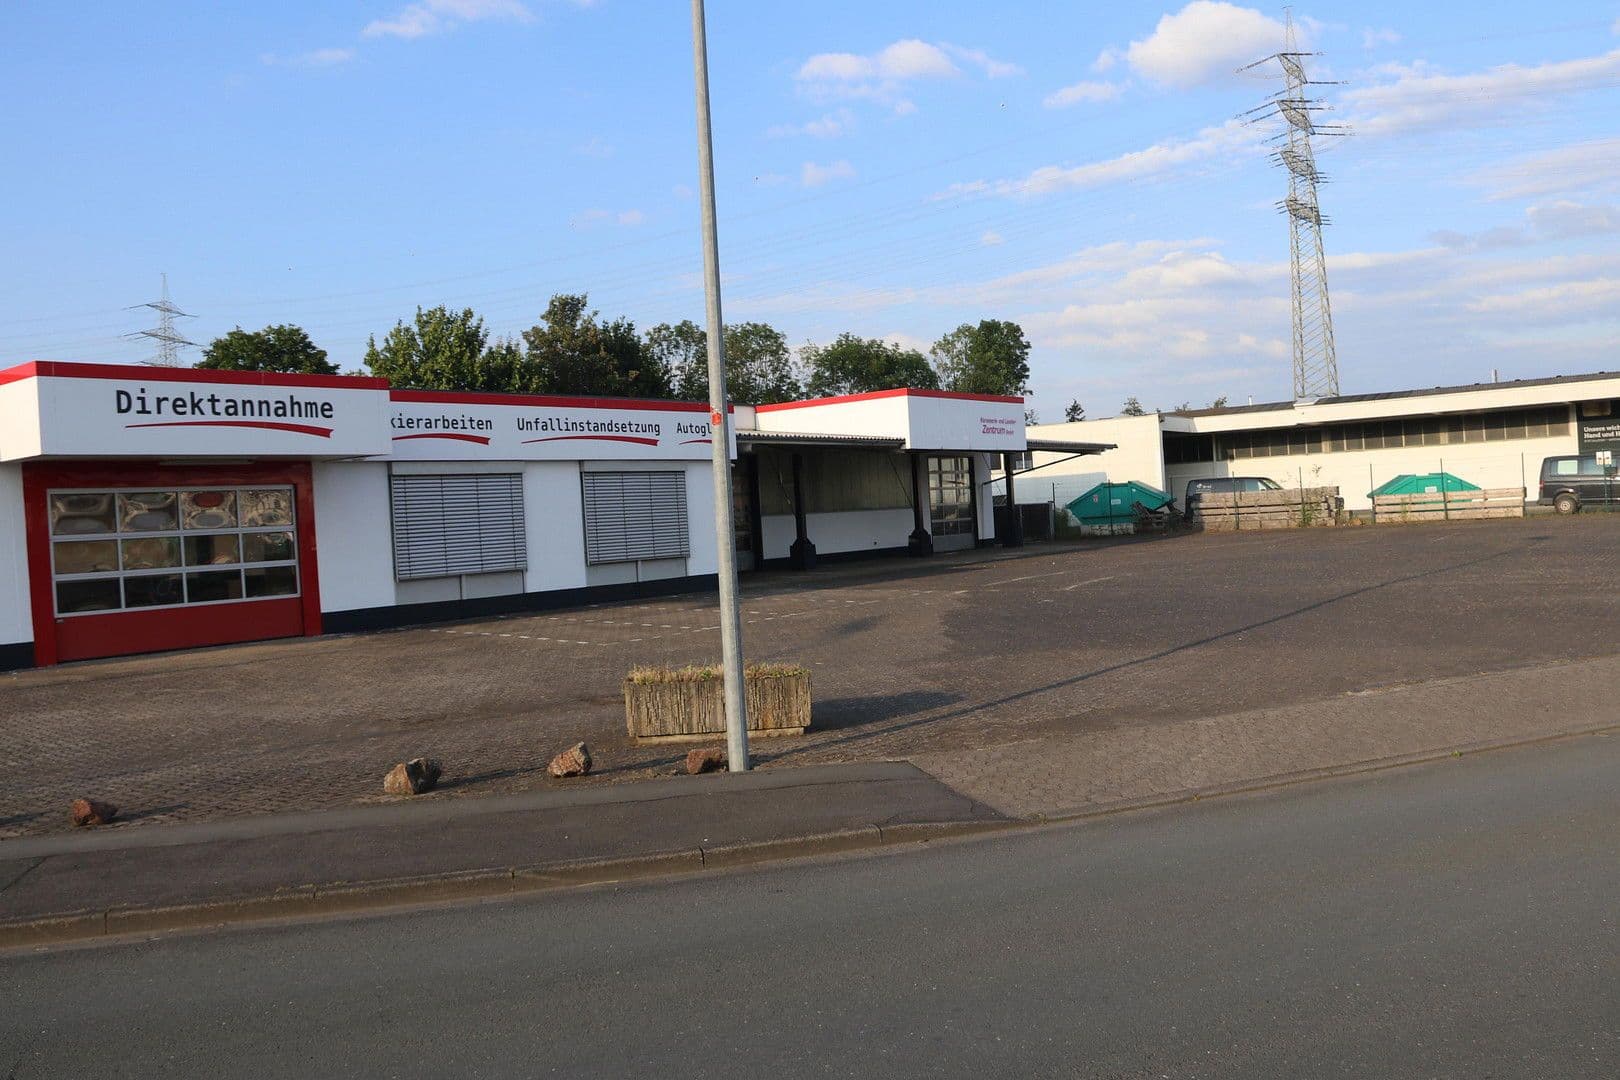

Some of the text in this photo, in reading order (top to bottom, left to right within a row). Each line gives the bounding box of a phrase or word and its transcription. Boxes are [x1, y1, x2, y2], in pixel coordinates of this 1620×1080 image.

[115, 387, 334, 419] Direktannahme
[516, 417, 661, 436] Unfallinstandsetzung
[982, 424, 1006, 434] Zentrum
